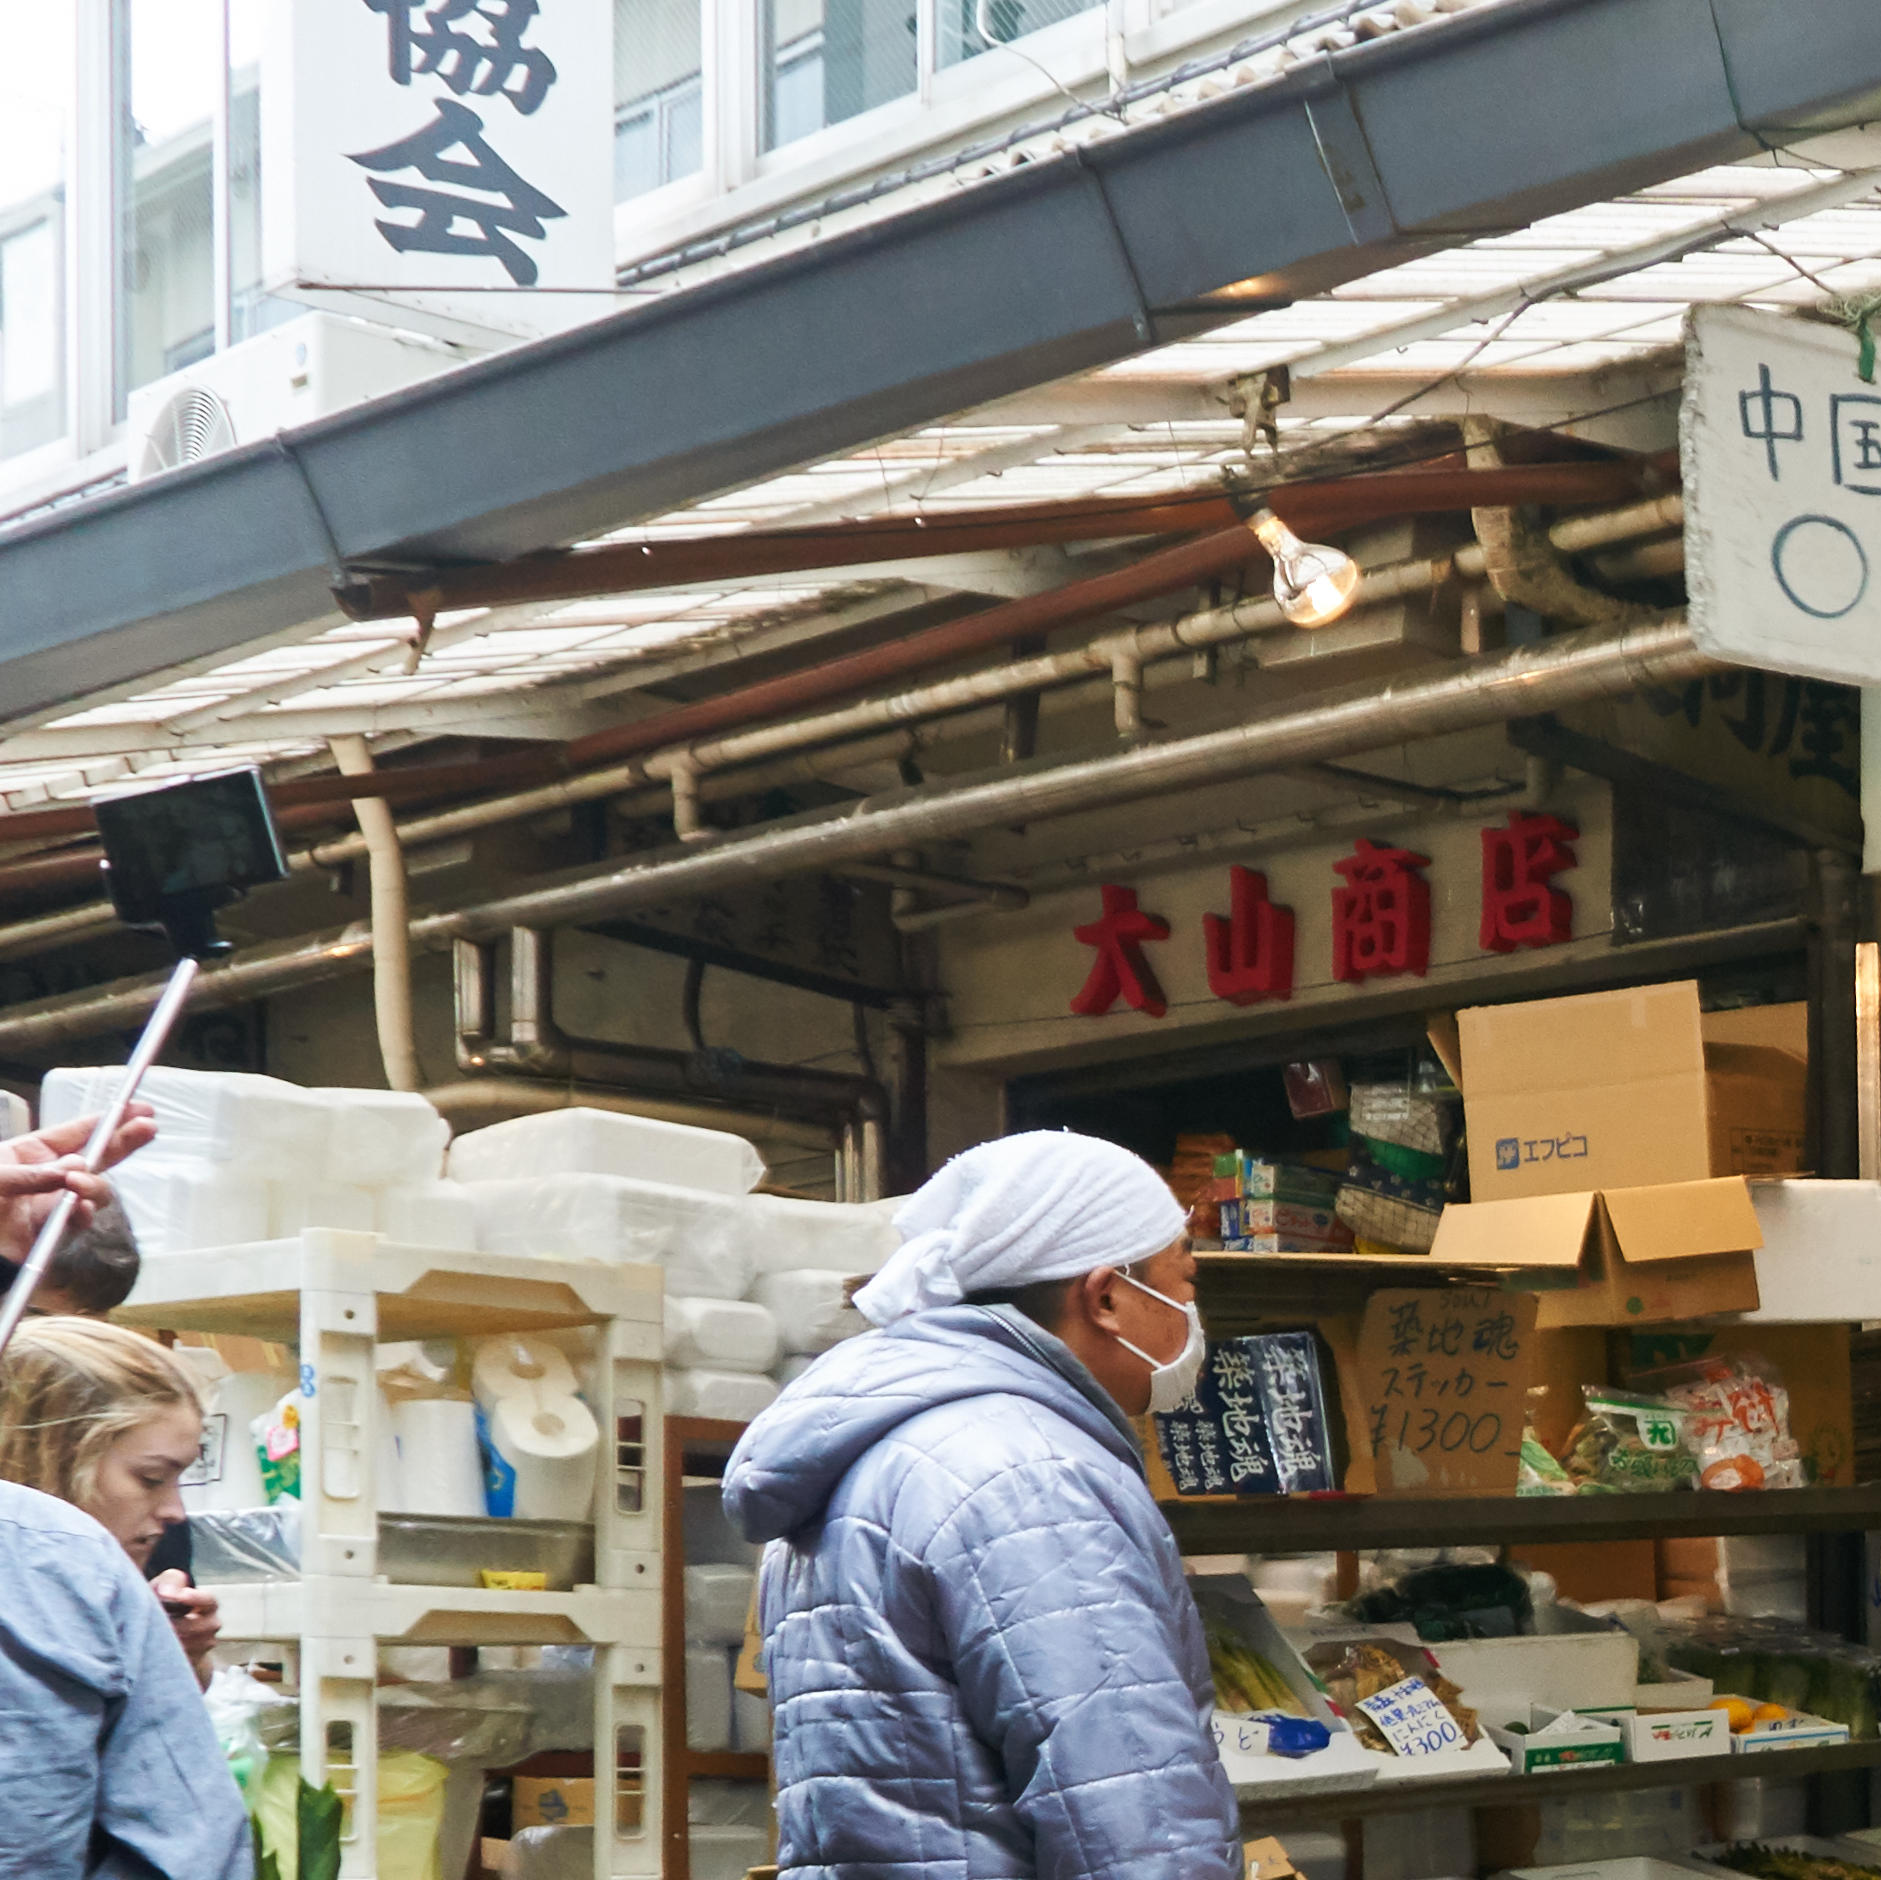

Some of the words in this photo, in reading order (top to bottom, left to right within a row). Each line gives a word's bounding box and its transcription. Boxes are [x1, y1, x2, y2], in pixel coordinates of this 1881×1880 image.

[1070, 811, 1583, 1019] 大山商店
[1523, 1132, 1588, 1162] エフピコ
[1381, 1361, 1510, 1399] ステッカー
